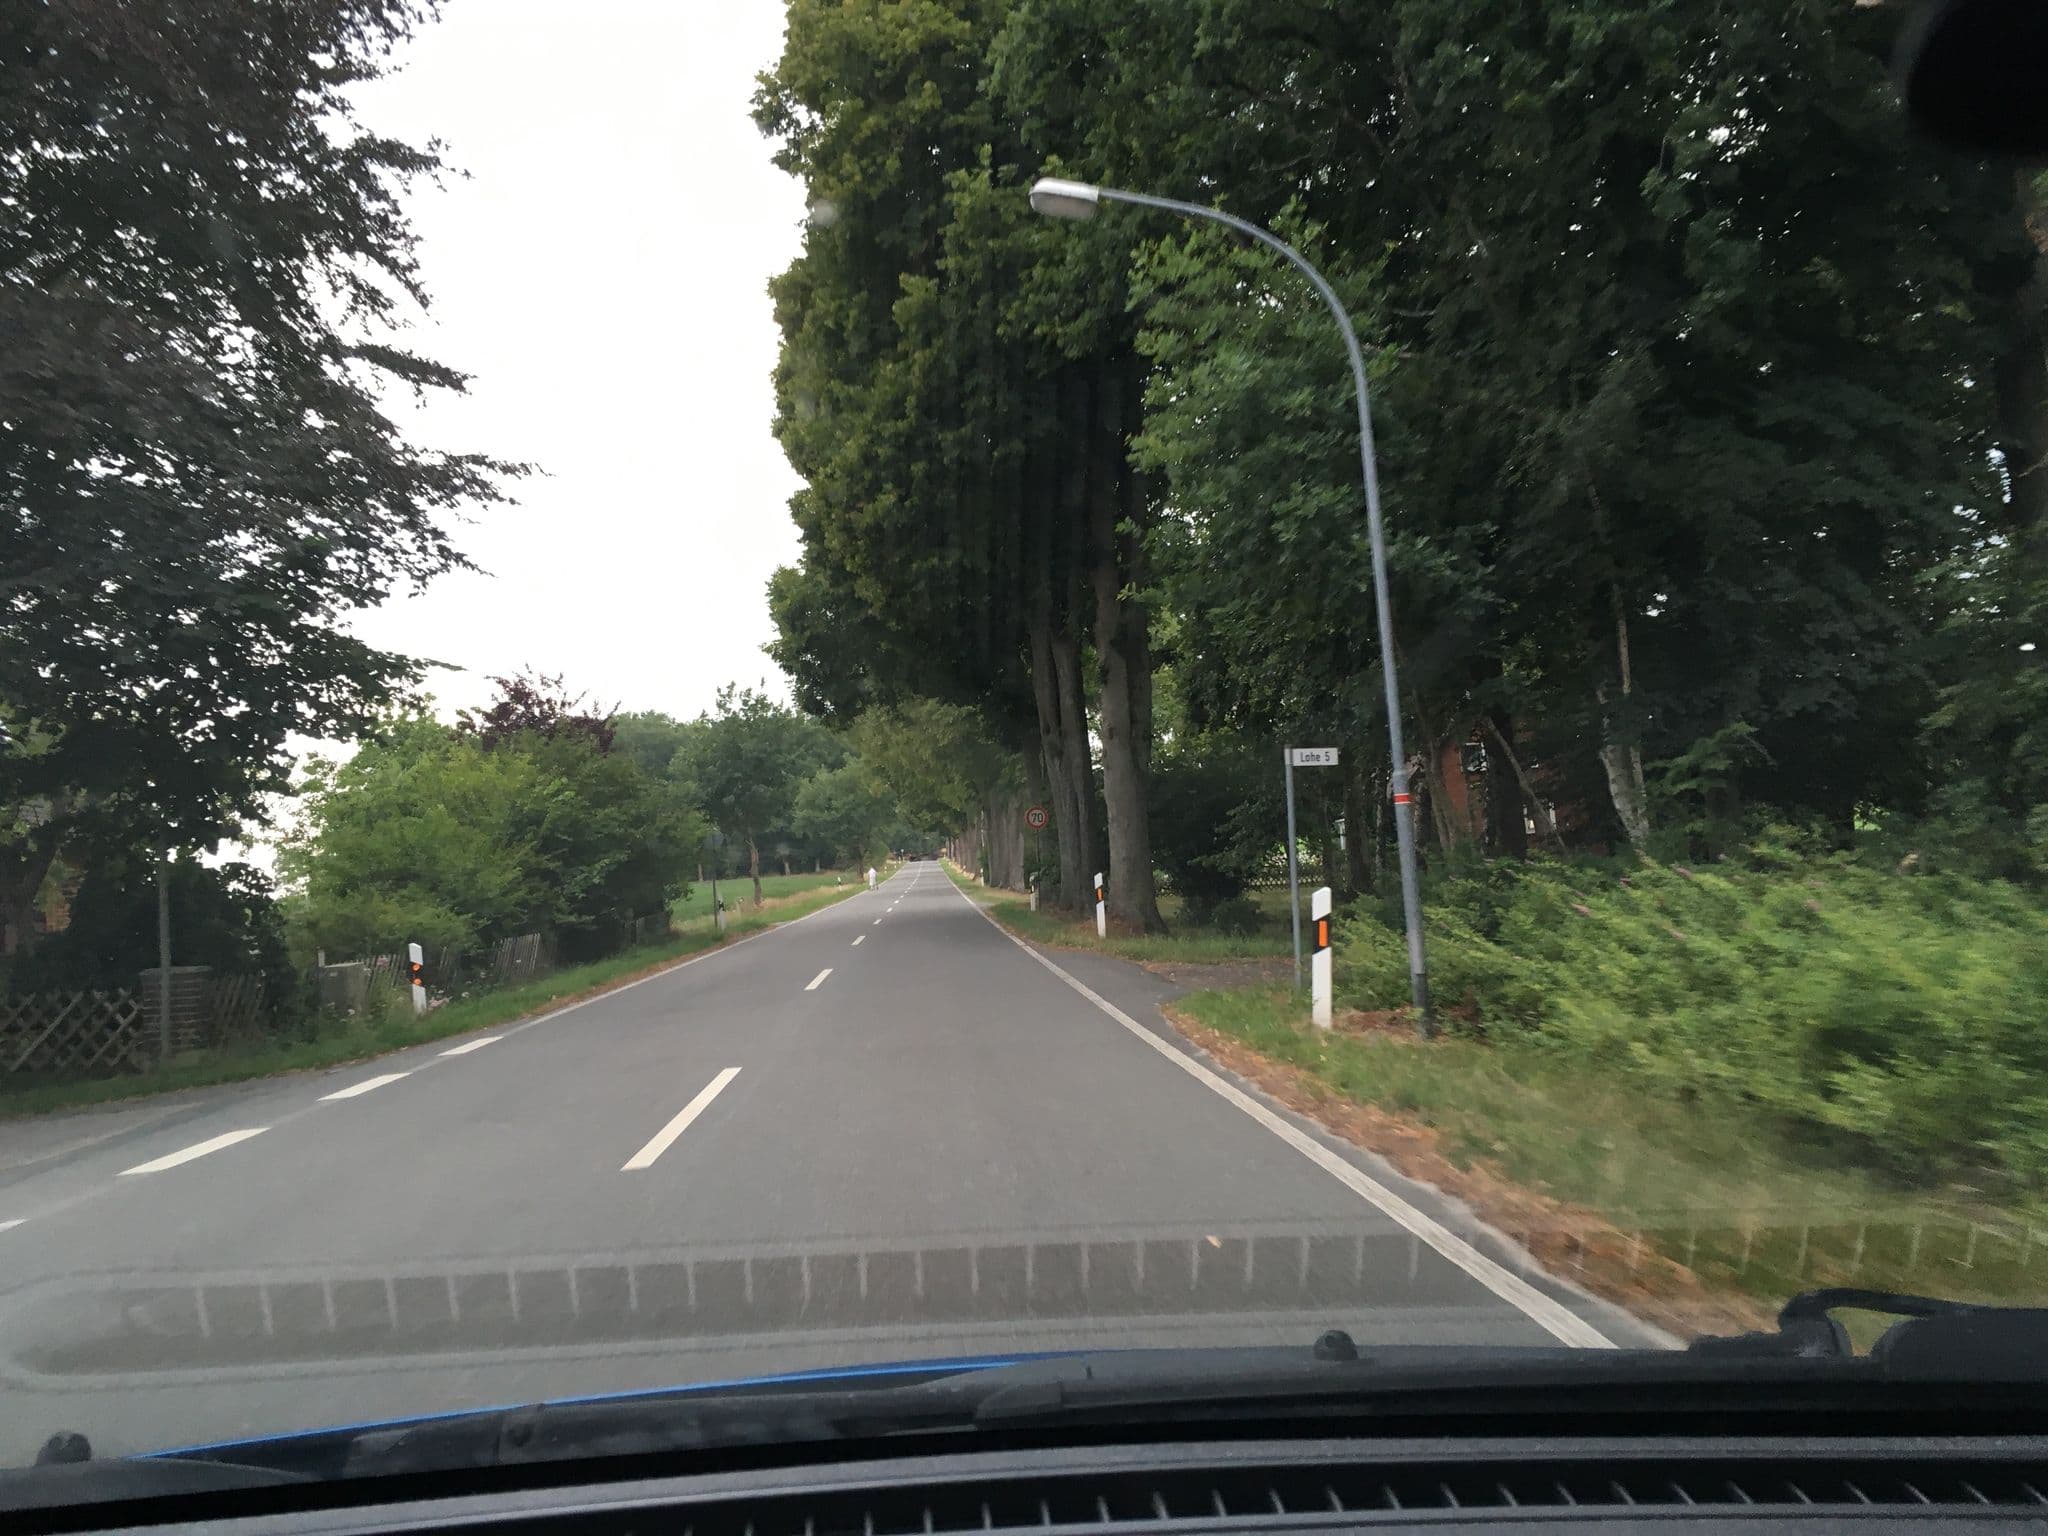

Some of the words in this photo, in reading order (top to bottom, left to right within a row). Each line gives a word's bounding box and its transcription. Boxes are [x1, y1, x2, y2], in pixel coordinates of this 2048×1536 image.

[1300, 751, 1321, 763] Lohe
[1324, 751, 1330, 762] 5
[1031, 812, 1044, 823] 70
